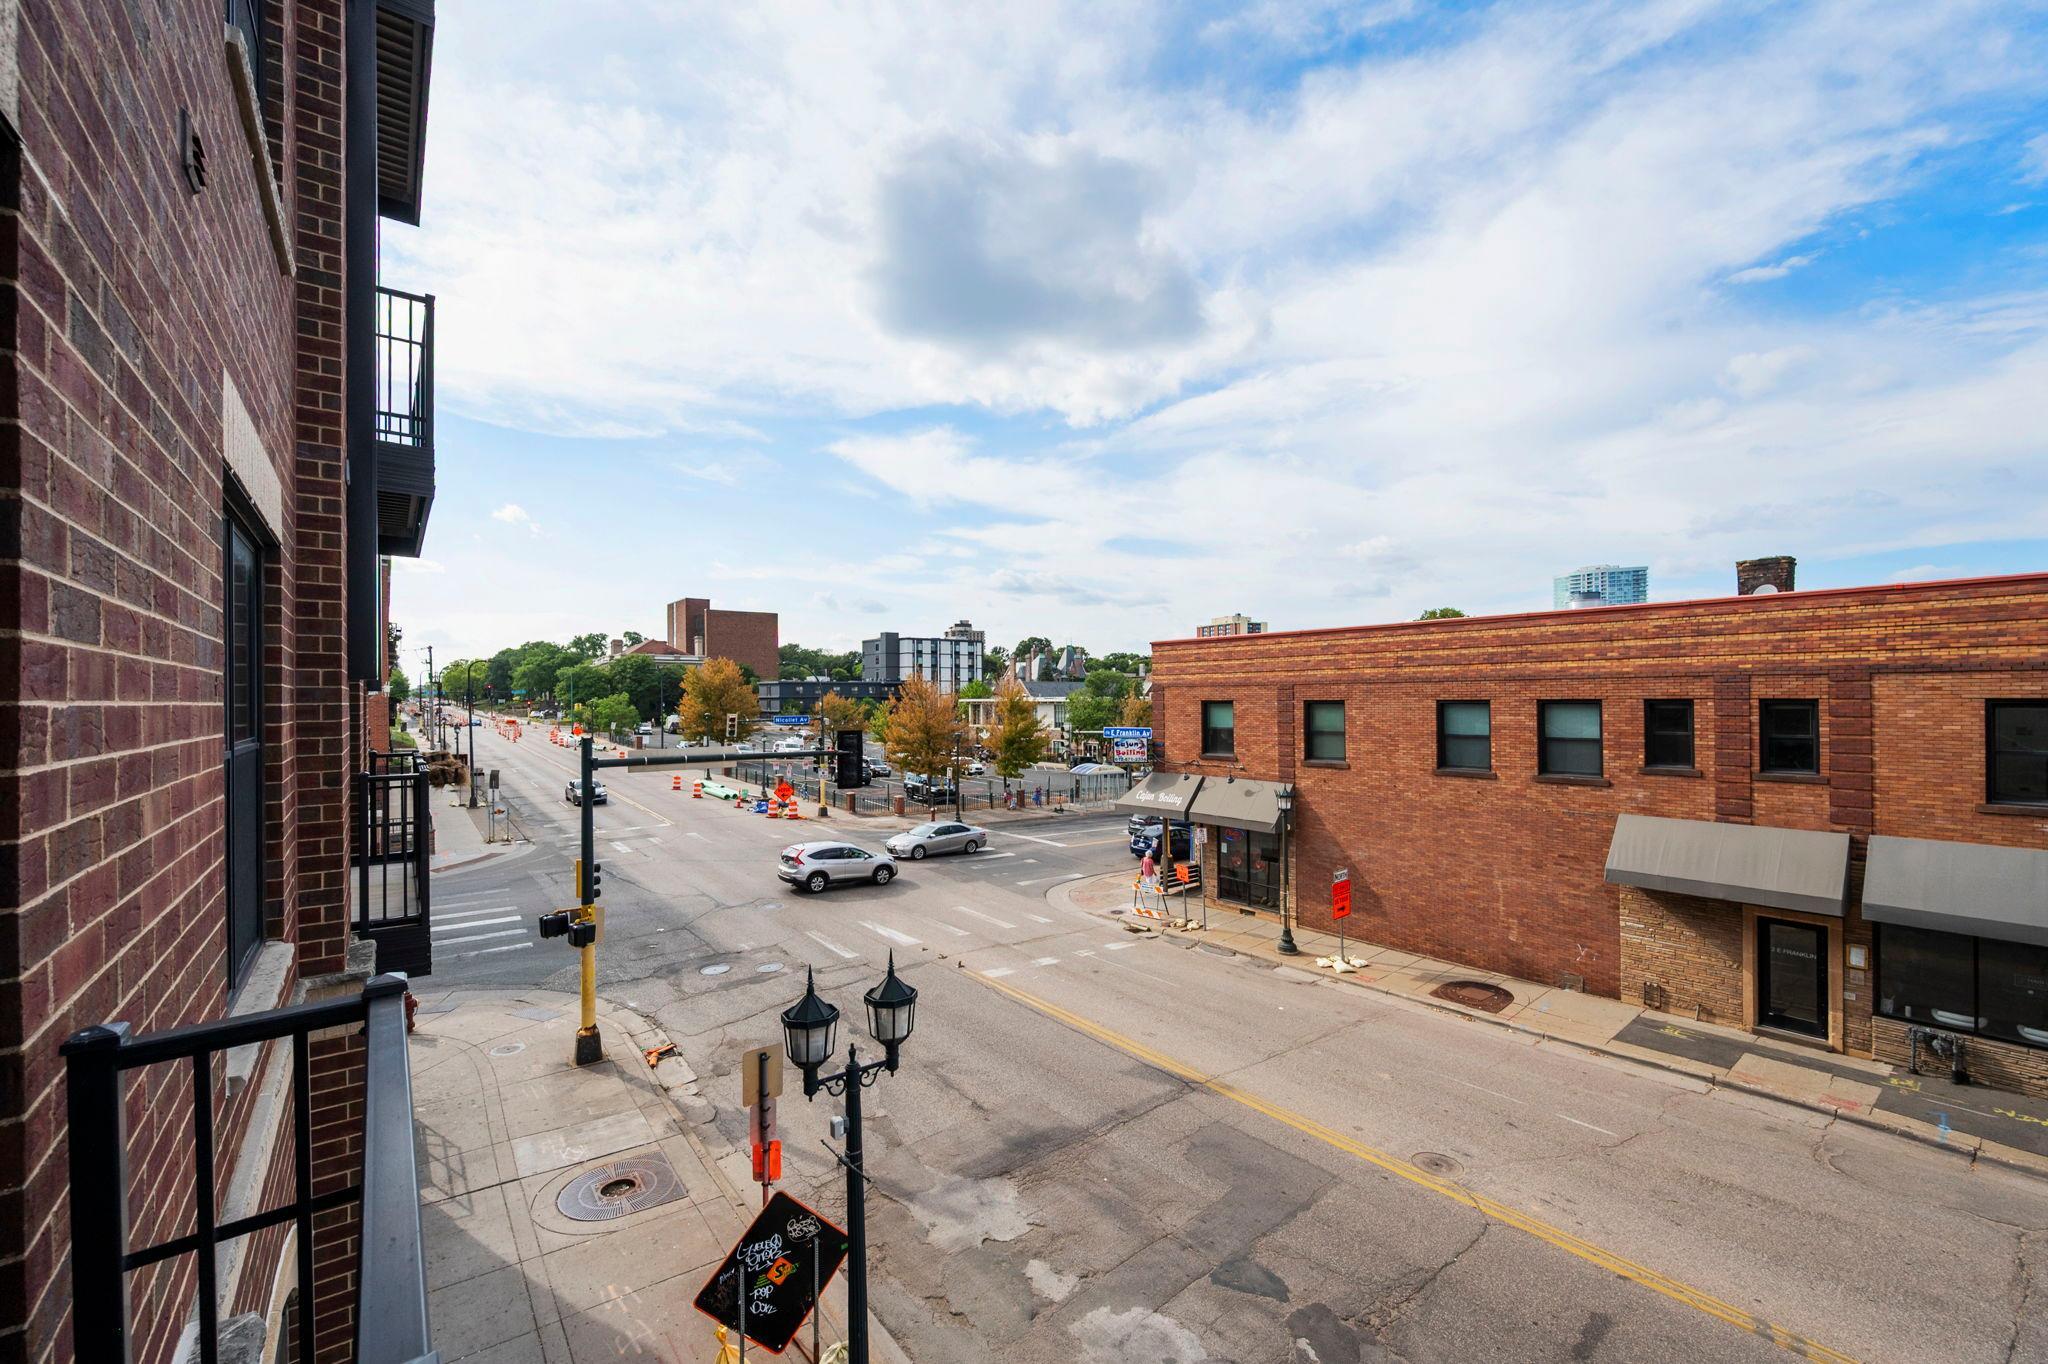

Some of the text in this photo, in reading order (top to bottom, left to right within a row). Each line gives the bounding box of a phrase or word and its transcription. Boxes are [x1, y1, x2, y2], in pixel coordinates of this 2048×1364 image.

[1114, 741, 1139, 749] Cajun
[1115, 749, 1146, 757] Boiling
[1136, 790, 1183, 806] Cajun Boiling
[1783, 948, 1817, 959] FRANKLIN
